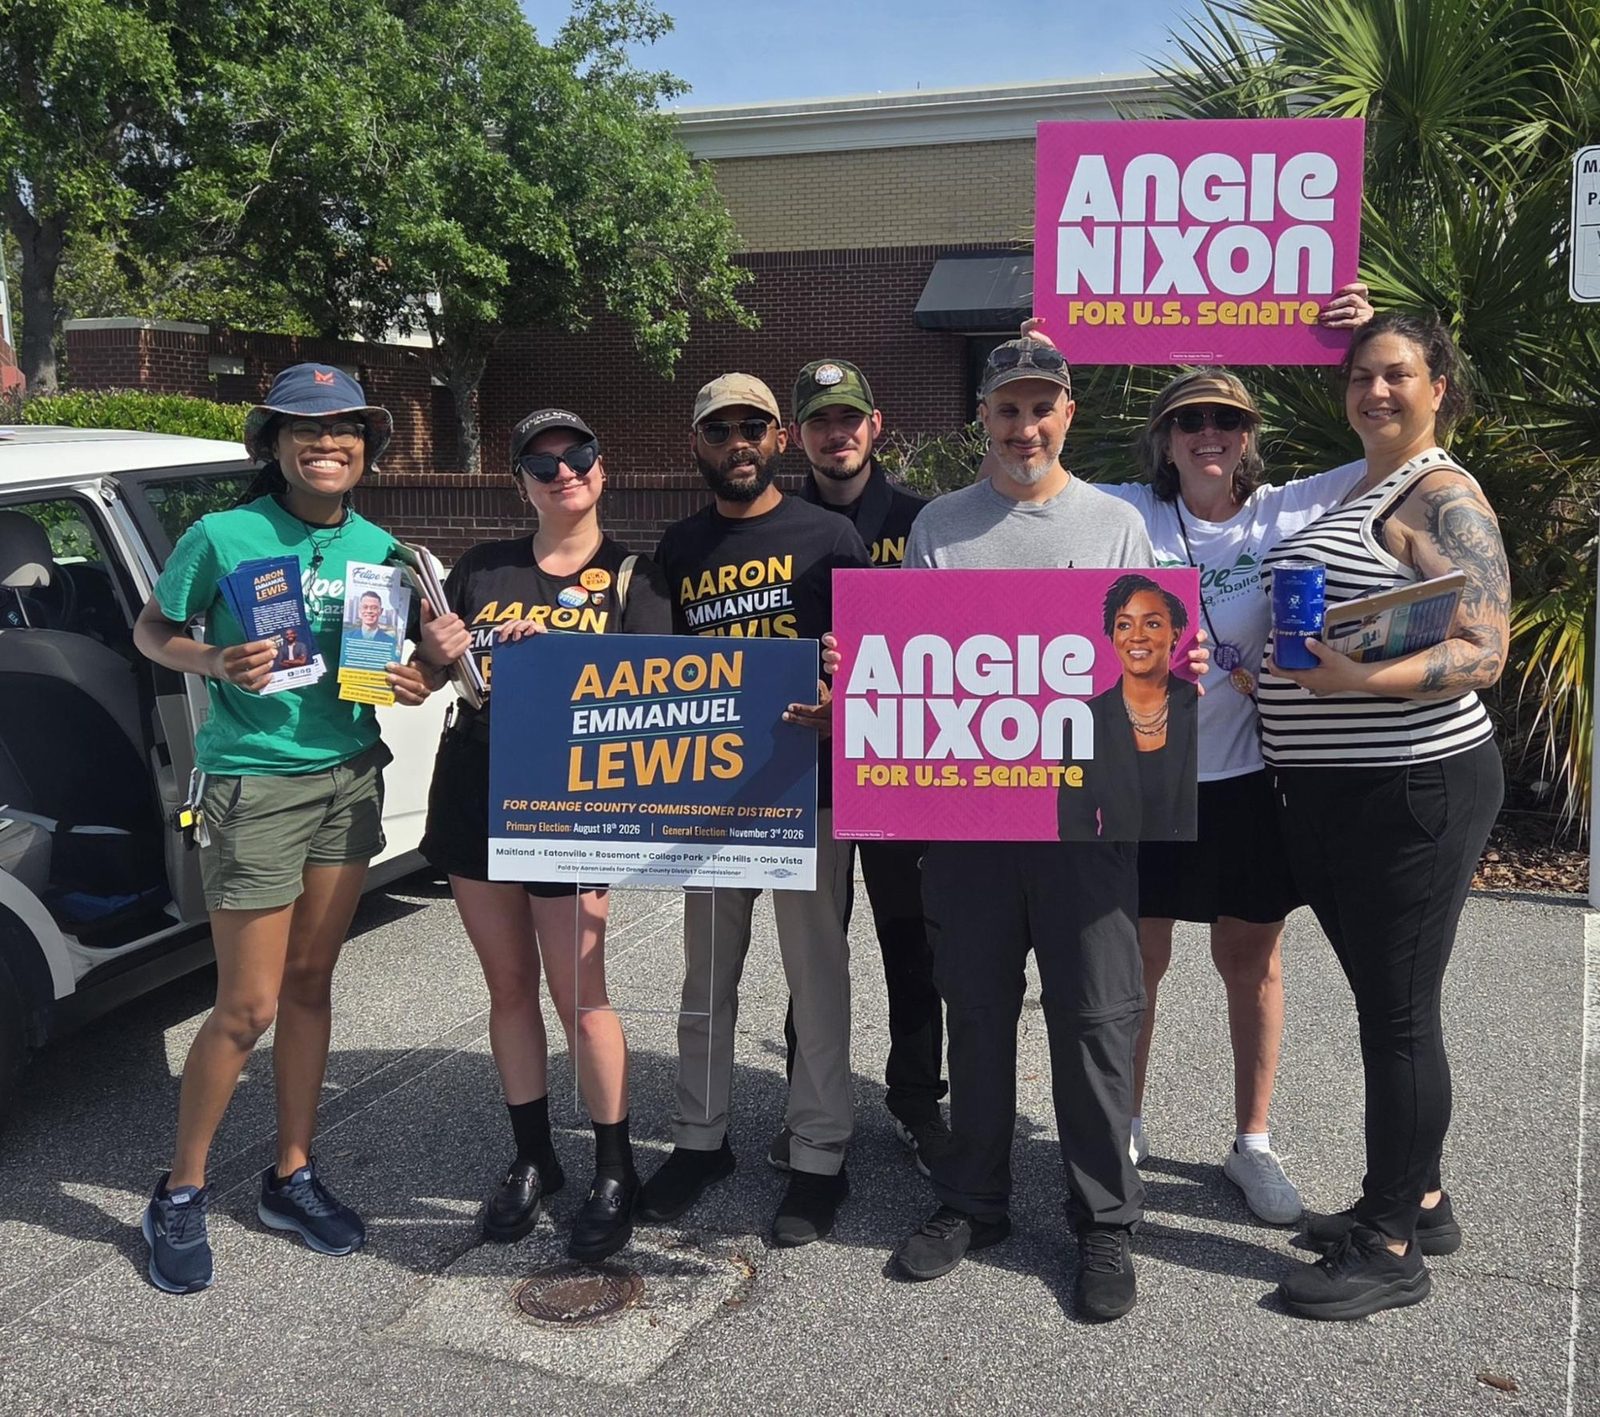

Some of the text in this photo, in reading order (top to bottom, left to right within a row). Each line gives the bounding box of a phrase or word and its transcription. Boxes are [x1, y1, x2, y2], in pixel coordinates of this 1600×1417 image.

[1068, 302, 1126, 324] FOR
[1133, 302, 1191, 324] U.S.
[254, 569, 284, 585] AARON
[680, 555, 793, 605] AARON
[256, 582, 288, 600] LEWIS
[472, 601, 608, 634] AARON
[570, 650, 743, 701] AARON
[573, 698, 741, 735] EMMANUEL
[568, 733, 744, 792] LEWIS
[857, 765, 910, 786] FOR
[914, 765, 967, 787] U.S.
[503, 800, 803, 818] FOR ORANGE COUNTY COMMISSIONER DISTRICT 7
[506, 821, 536, 833] Primary
[538, 822, 572, 832] Election:
[573, 823, 600, 835] August
[619, 824, 641, 835] 2026
[662, 825, 692, 836] General
[694, 826, 726, 837] Election:
[729, 827, 768, 838] November
[783, 829, 804, 840] 2026
[496, 848, 535, 856] Maitland
[544, 849, 587, 858] Eatonville
[595, 850, 640, 859] Rosemont
[649, 853, 682, 862] College
[683, 854, 703, 862] Park
[712, 854, 731, 862] Pine
[733, 855, 751, 863] Hills
[780, 857, 803, 865] Vista
[626, 866, 648, 874] Orange
